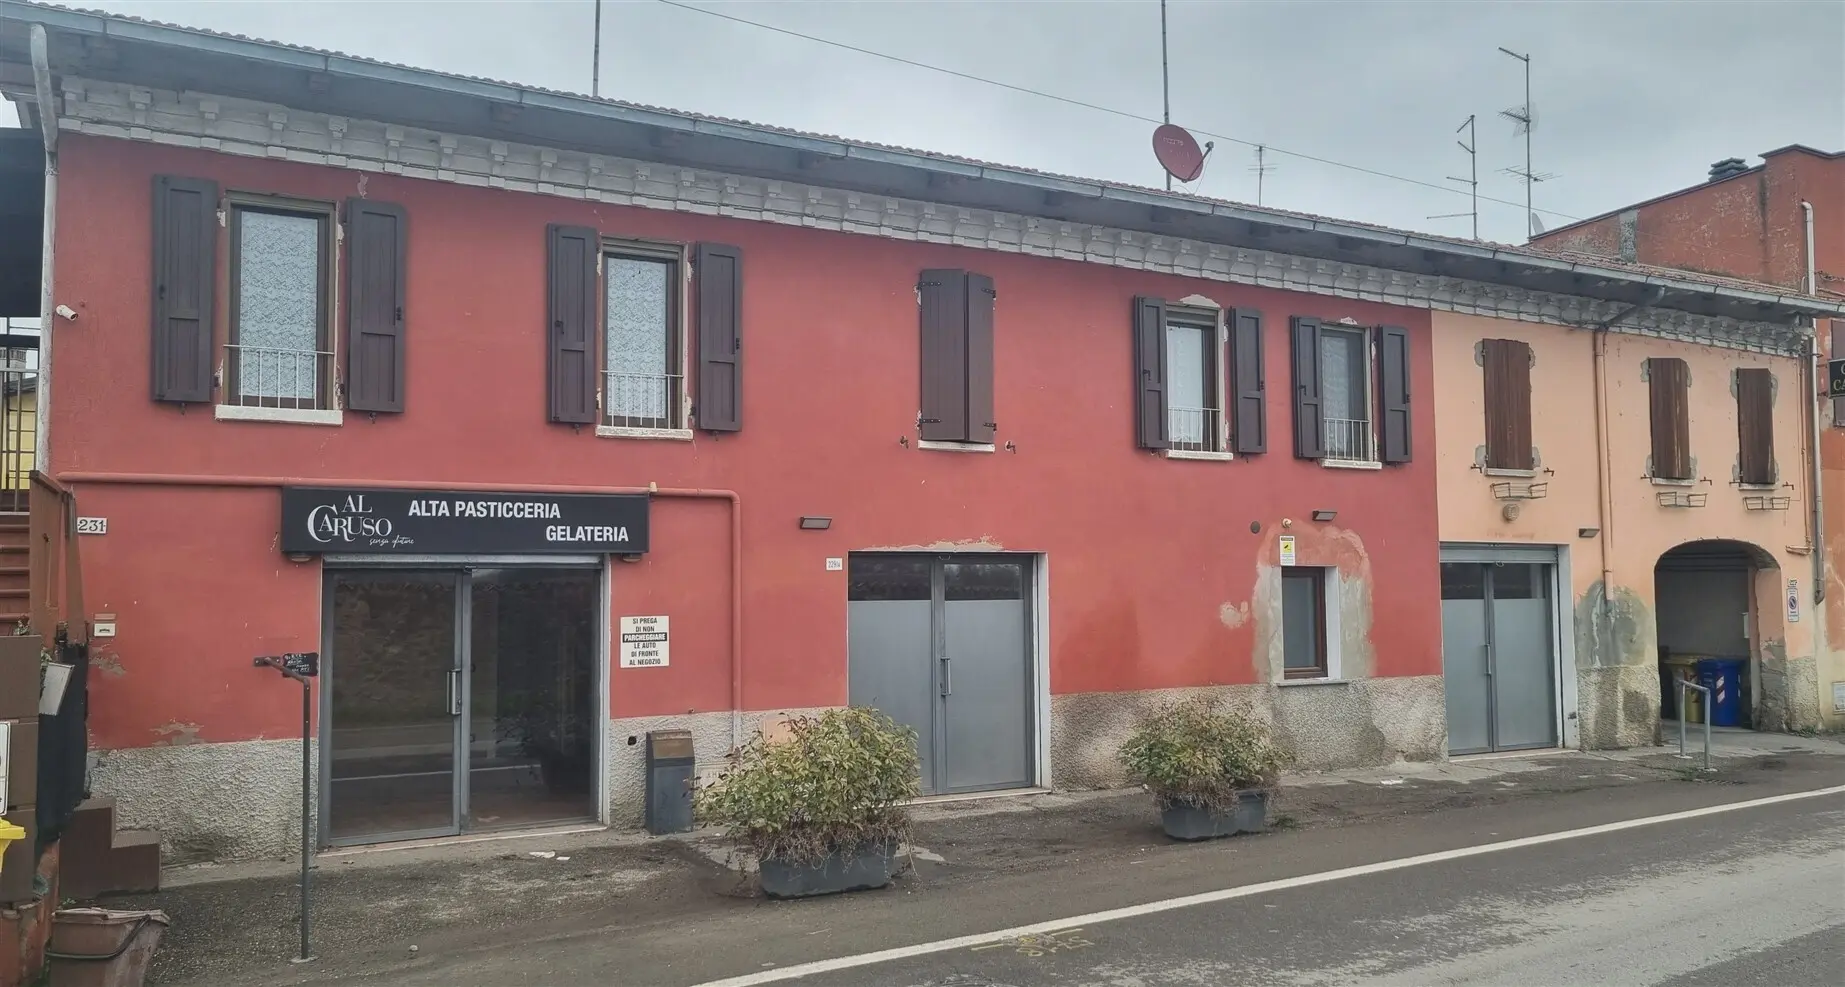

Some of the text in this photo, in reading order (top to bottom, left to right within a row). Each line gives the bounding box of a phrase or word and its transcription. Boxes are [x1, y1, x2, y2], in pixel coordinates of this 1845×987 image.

[341, 494, 373, 513] AL
[408, 500, 561, 519] ALTA PASTICCERIA
[79, 519, 104, 532] 231
[307, 504, 392, 543] CARUSO
[545, 525, 629, 542] GELATERIA
[624, 633, 666, 641] PARCHEGGIARE
